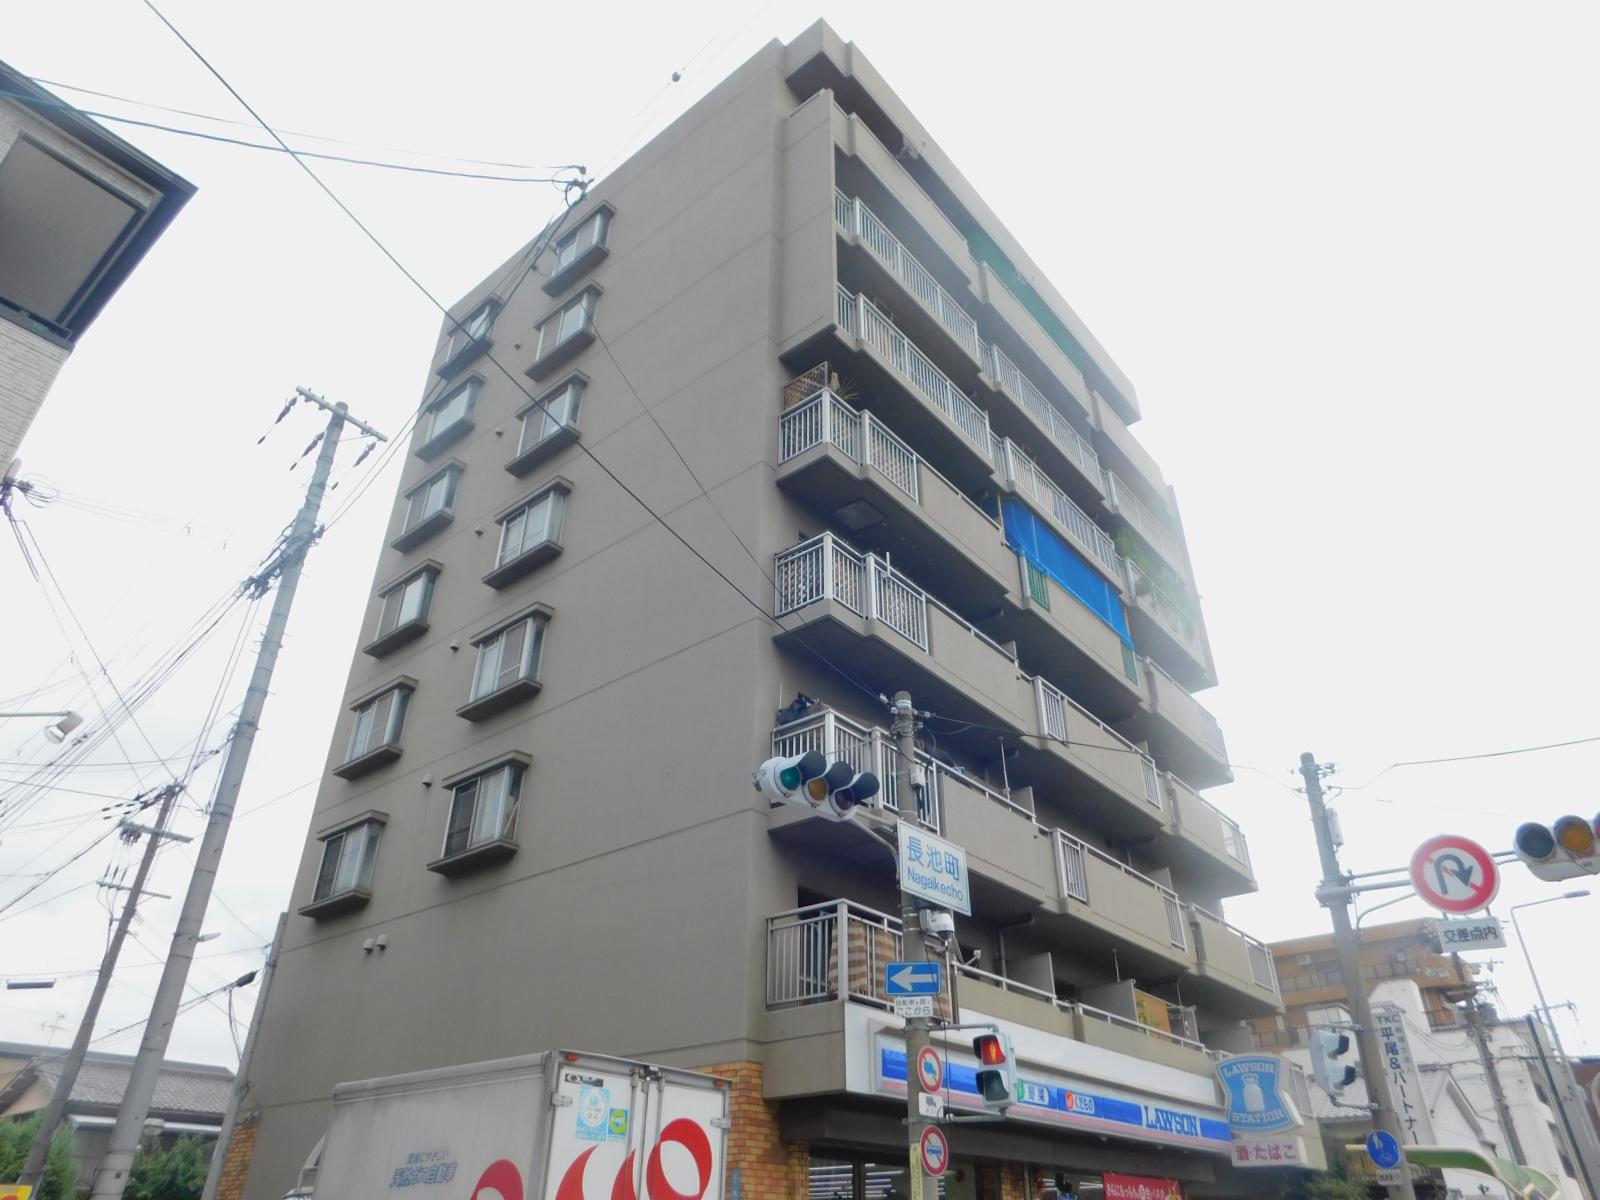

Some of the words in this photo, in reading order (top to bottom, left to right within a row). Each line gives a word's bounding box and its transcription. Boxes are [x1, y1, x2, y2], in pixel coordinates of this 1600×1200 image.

[907, 836, 960, 881] 長池町
[907, 867, 963, 901] Nagaikecho
[1443, 925, 1498, 944] 交差点内
[896, 1006, 931, 1016] ここから
[1375, 1014, 1401, 1024] TKC
[1223, 1062, 1277, 1077] LAWSON
[1075, 1095, 1094, 1114] くだもの
[1143, 1104, 1199, 1137] LAWSON
[1232, 1107, 1287, 1123] STATION
